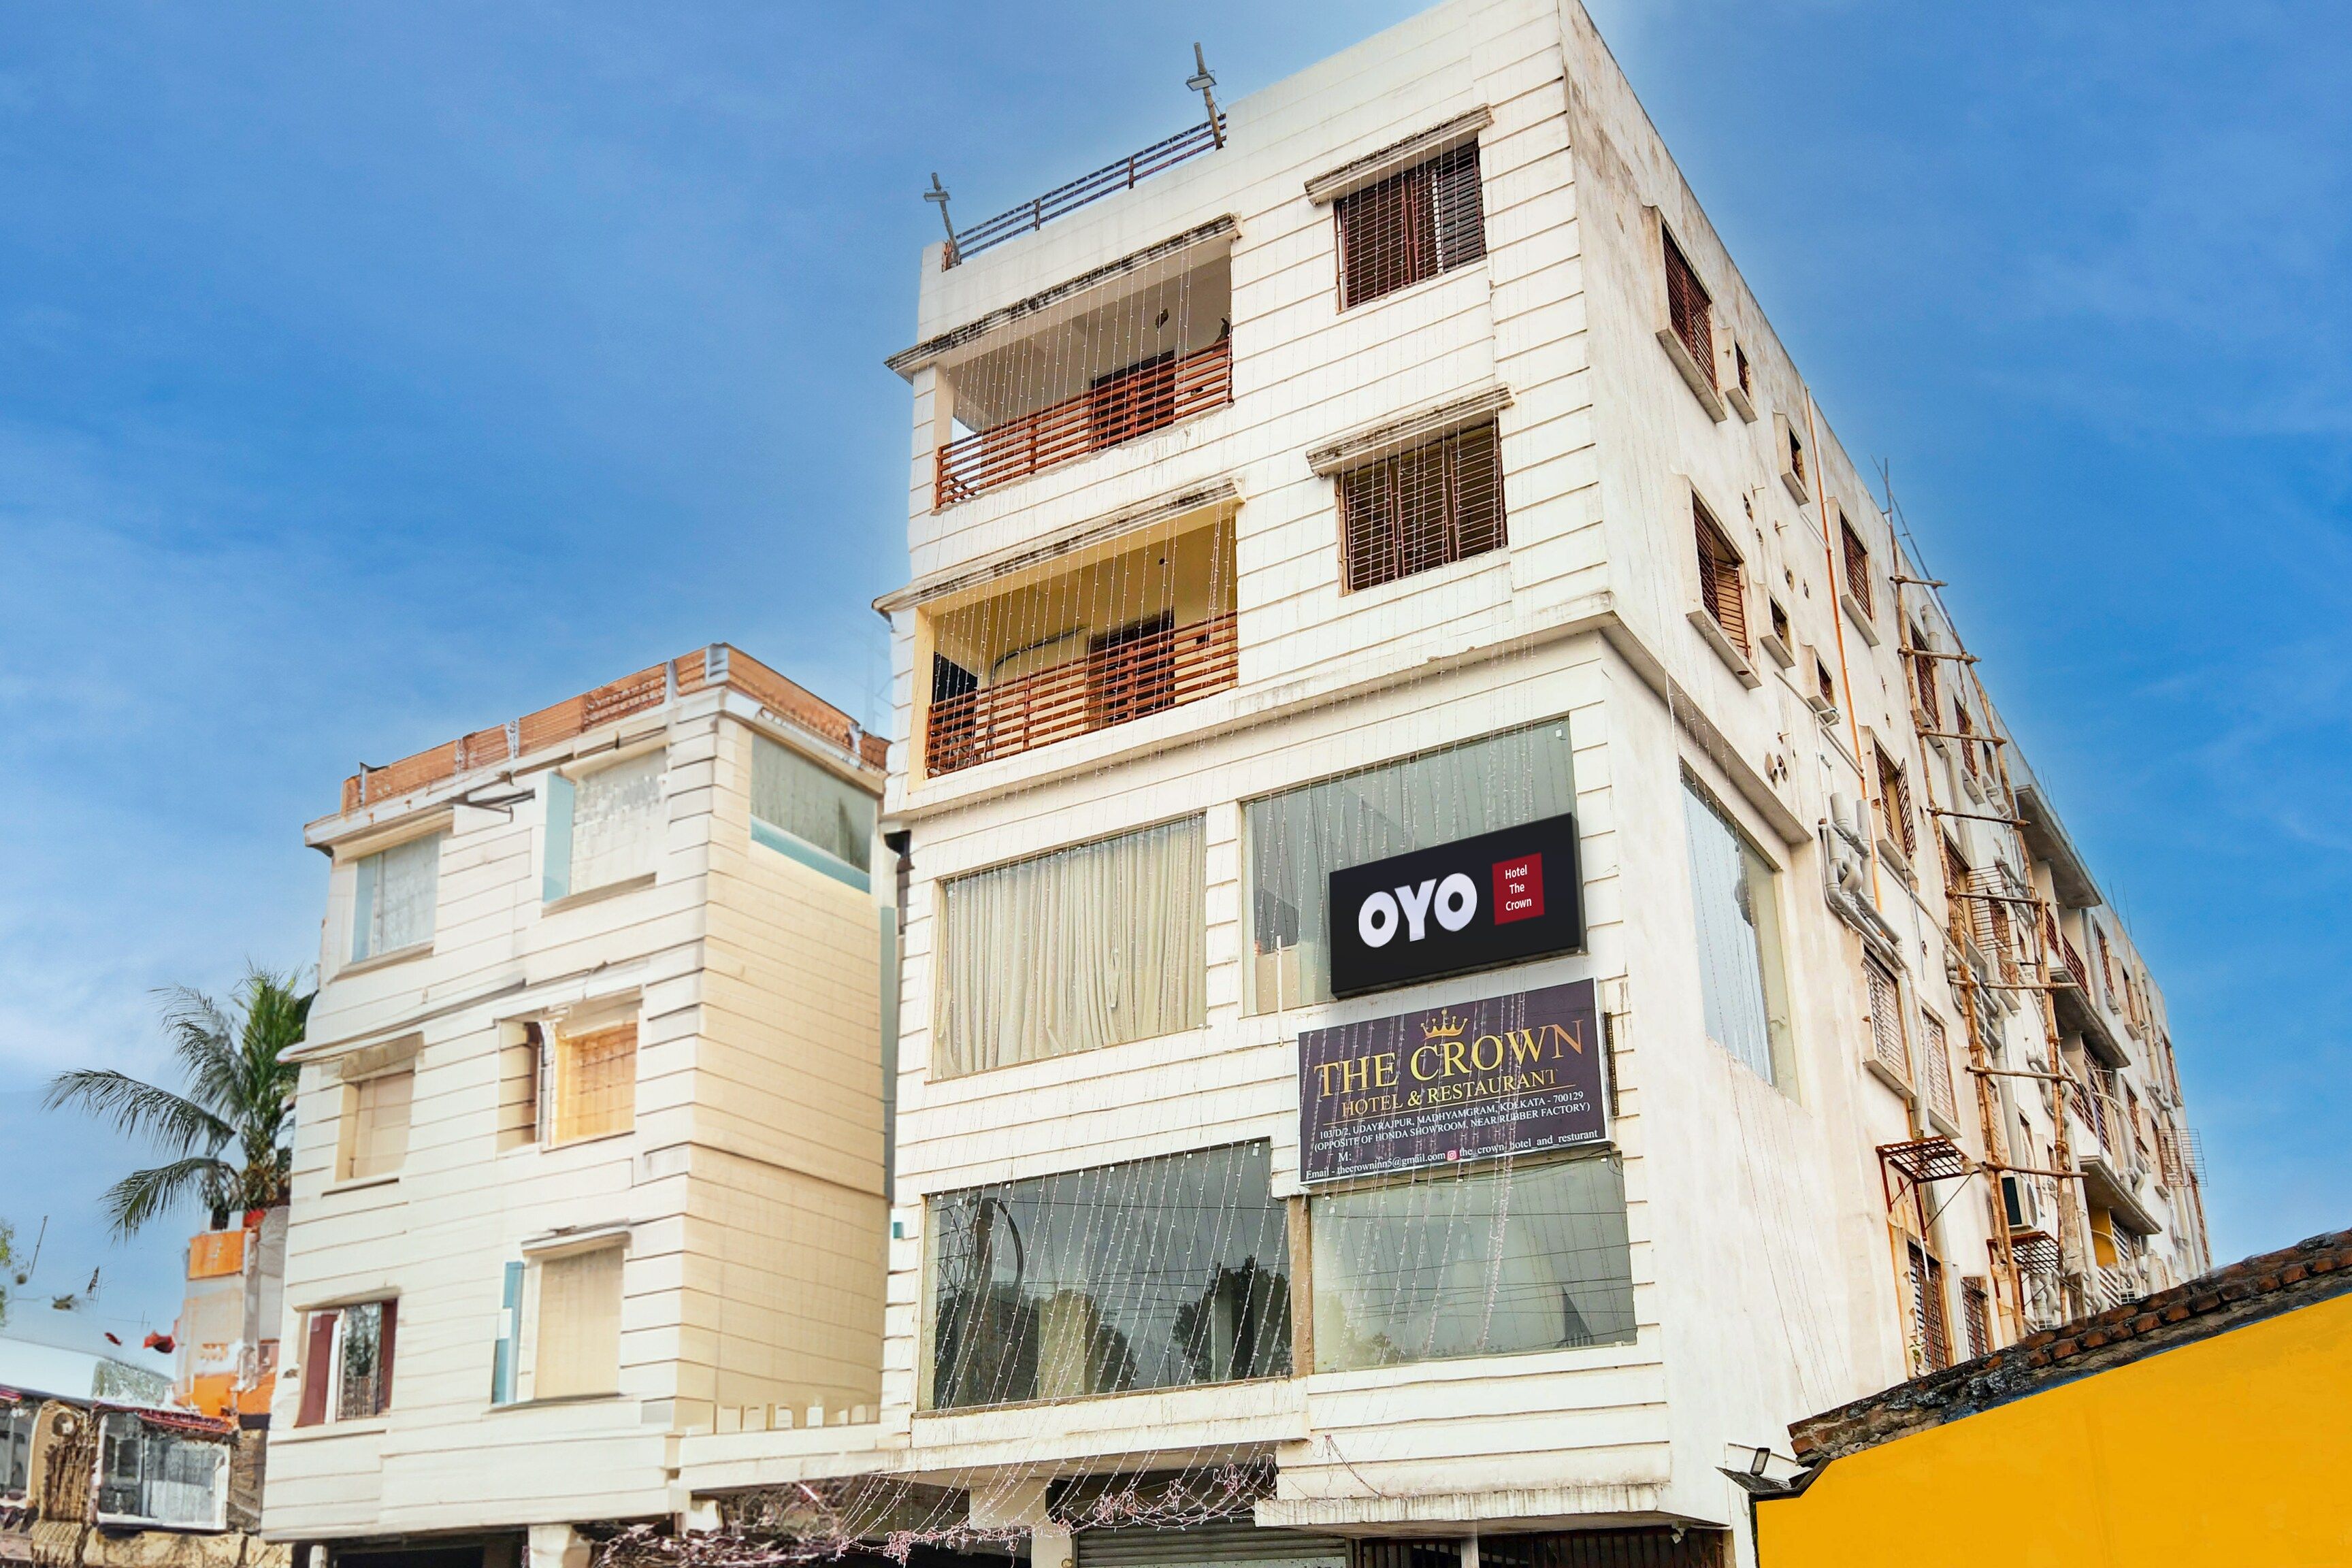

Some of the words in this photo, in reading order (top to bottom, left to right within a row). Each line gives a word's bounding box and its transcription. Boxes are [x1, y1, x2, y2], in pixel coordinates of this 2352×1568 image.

[1505, 864, 1527, 879] Hotel
[1509, 883, 1524, 894] The
[1358, 872, 1477, 948] OYO
[1505, 898, 1532, 911] Crown
[1313, 1052, 1399, 1097] THE
[1409, 1019, 1584, 1081] CROWN
[1341, 1094, 1403, 1117] HOTEL
[1407, 1090, 1422, 1107] &
[1427, 1069, 1556, 1104] RESTAURANT
[1352, 1117, 1415, 1134] UDAYRAJPUR,
[1416, 1104, 1498, 1124] MADHYAMGRAM,
[1500, 1097, 1546, 1112] KOLKATA
[1553, 1090, 1584, 1103] 700129
[1314, 1137, 1359, 1152] (OPPOSITE
[1361, 1134, 1373, 1144] OF
[1375, 1128, 1408, 1141] HONDA
[1409, 1122, 1469, 1137] SHOWROOM,
[1471, 1115, 1497, 1128] NEAR
[1499, 1110, 1539, 1124] RUBBER
[1541, 1102, 1590, 1117] FACTORY)
[1338, 1152, 1352, 1162] M:
[1305, 1167, 1330, 1179] Email
